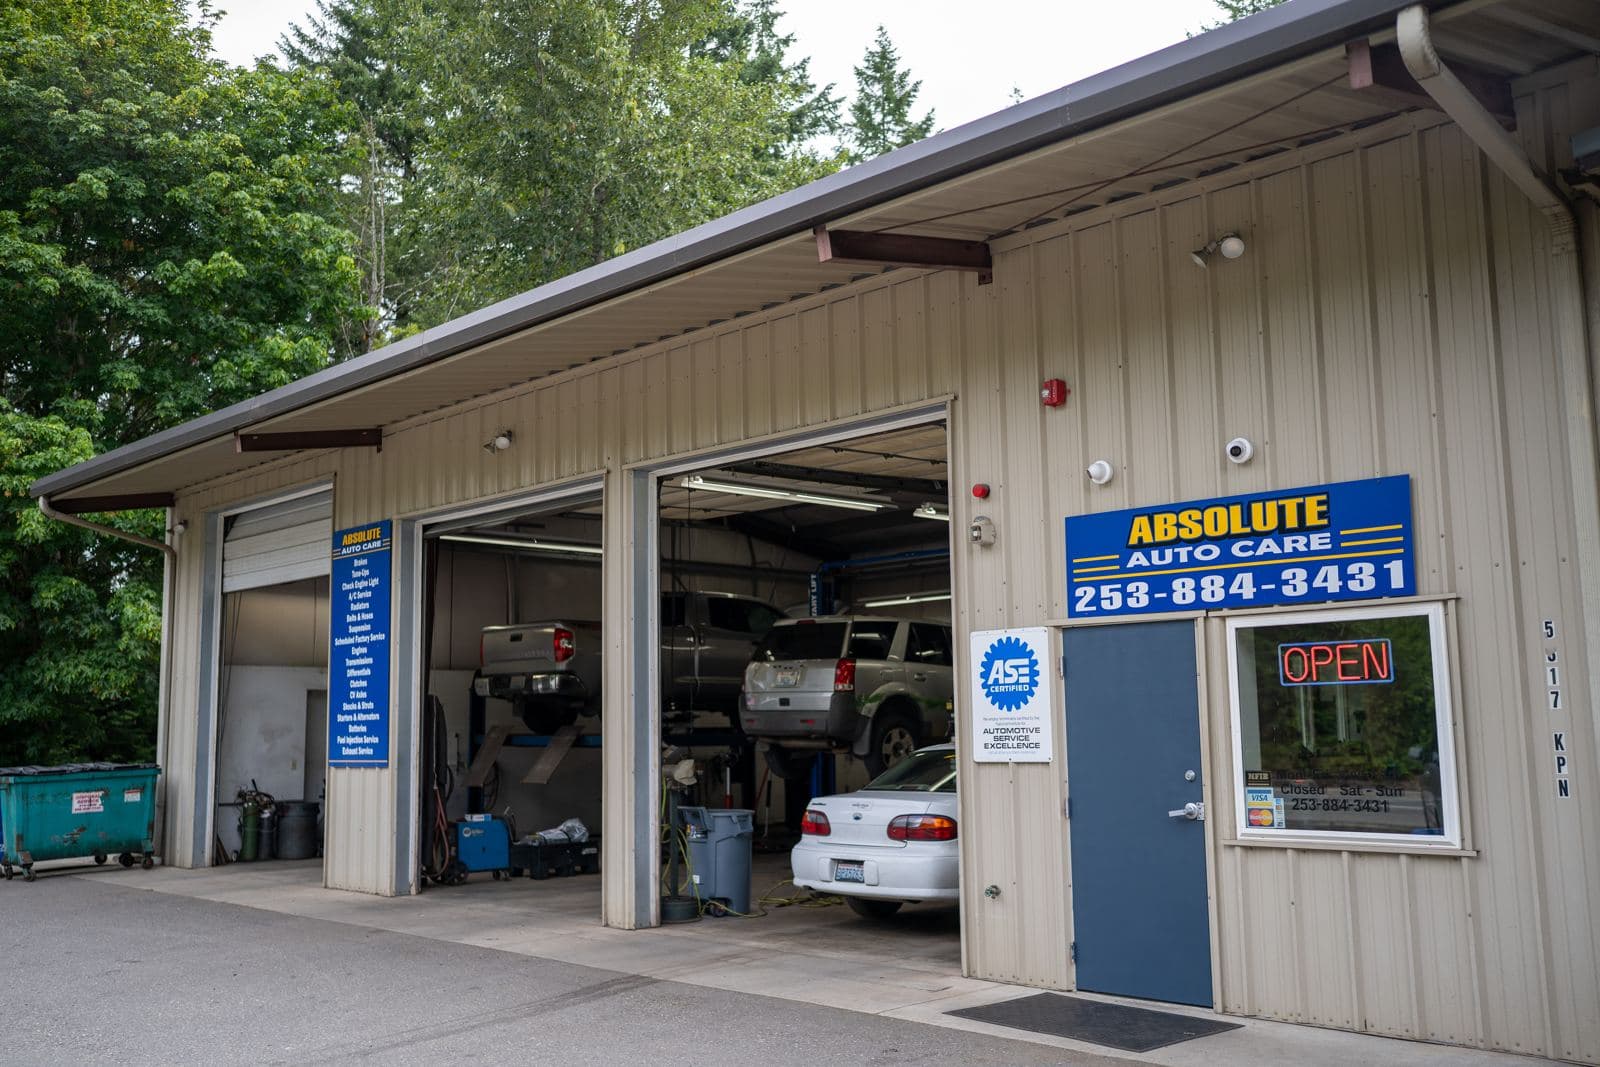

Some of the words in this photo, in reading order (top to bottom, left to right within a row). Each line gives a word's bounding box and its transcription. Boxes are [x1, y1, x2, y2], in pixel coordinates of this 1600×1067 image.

[1127, 493, 1330, 547] ABSOLUTE
[342, 527, 381, 546] ABSOLUTE
[341, 546, 361, 555] AUTO
[362, 540, 381, 550] CARE
[1126, 544, 1221, 568] AUTO
[1230, 533, 1332, 558] CARE
[353, 558, 368, 567] Brakes
[351, 568, 370, 578] Tune-Ups
[342, 582, 354, 591] Check
[354, 580, 369, 589] Engine
[368, 577, 379, 588] Light
[1075, 560, 1405, 613] 253-884-3431
[348, 592, 357, 601] A/C
[357, 590, 372, 599] Service
[350, 602, 369, 611] Radiators
[346, 614, 357, 623] Belts
[361, 612, 374, 621] Hoses
[348, 624, 371, 633] Suspension
[334, 637, 355, 646] Scheduled
[355, 635, 370, 644] Factory
[370, 632, 385, 641] Service
[351, 646, 368, 656] Engines
[345, 657, 373, 666] Transmissions
[1284, 643, 1388, 682] OPEN
[346, 667, 371, 677] Differentials
[987, 658, 1030, 684] ASE
[350, 679, 368, 688] Clutches
[990, 684, 1029, 693] CERTIFIED
[356, 690, 367, 699] Axles
[342, 702, 357, 711] Shocks
[361, 700, 374, 710] Struts
[337, 713, 353, 722] Starters
[357, 712, 380, 721] Alternators
[348, 724, 367, 733] Batteries
[983, 727, 1041, 735] AUTOMOTIVE
[337, 735, 346, 744] Fuel
[346, 735, 363, 746] Injection
[363, 735, 379, 744] Service
[983, 742, 1041, 750] EXCELLENCE
[342, 746, 358, 755] Exhaust
[358, 746, 373, 755] Service
[1554, 733, 1569, 797] KPN
[1281, 784, 1325, 796] Closed
[1376, 785, 1405, 797] Sun
[1292, 798, 1390, 814] 253-884-3431
